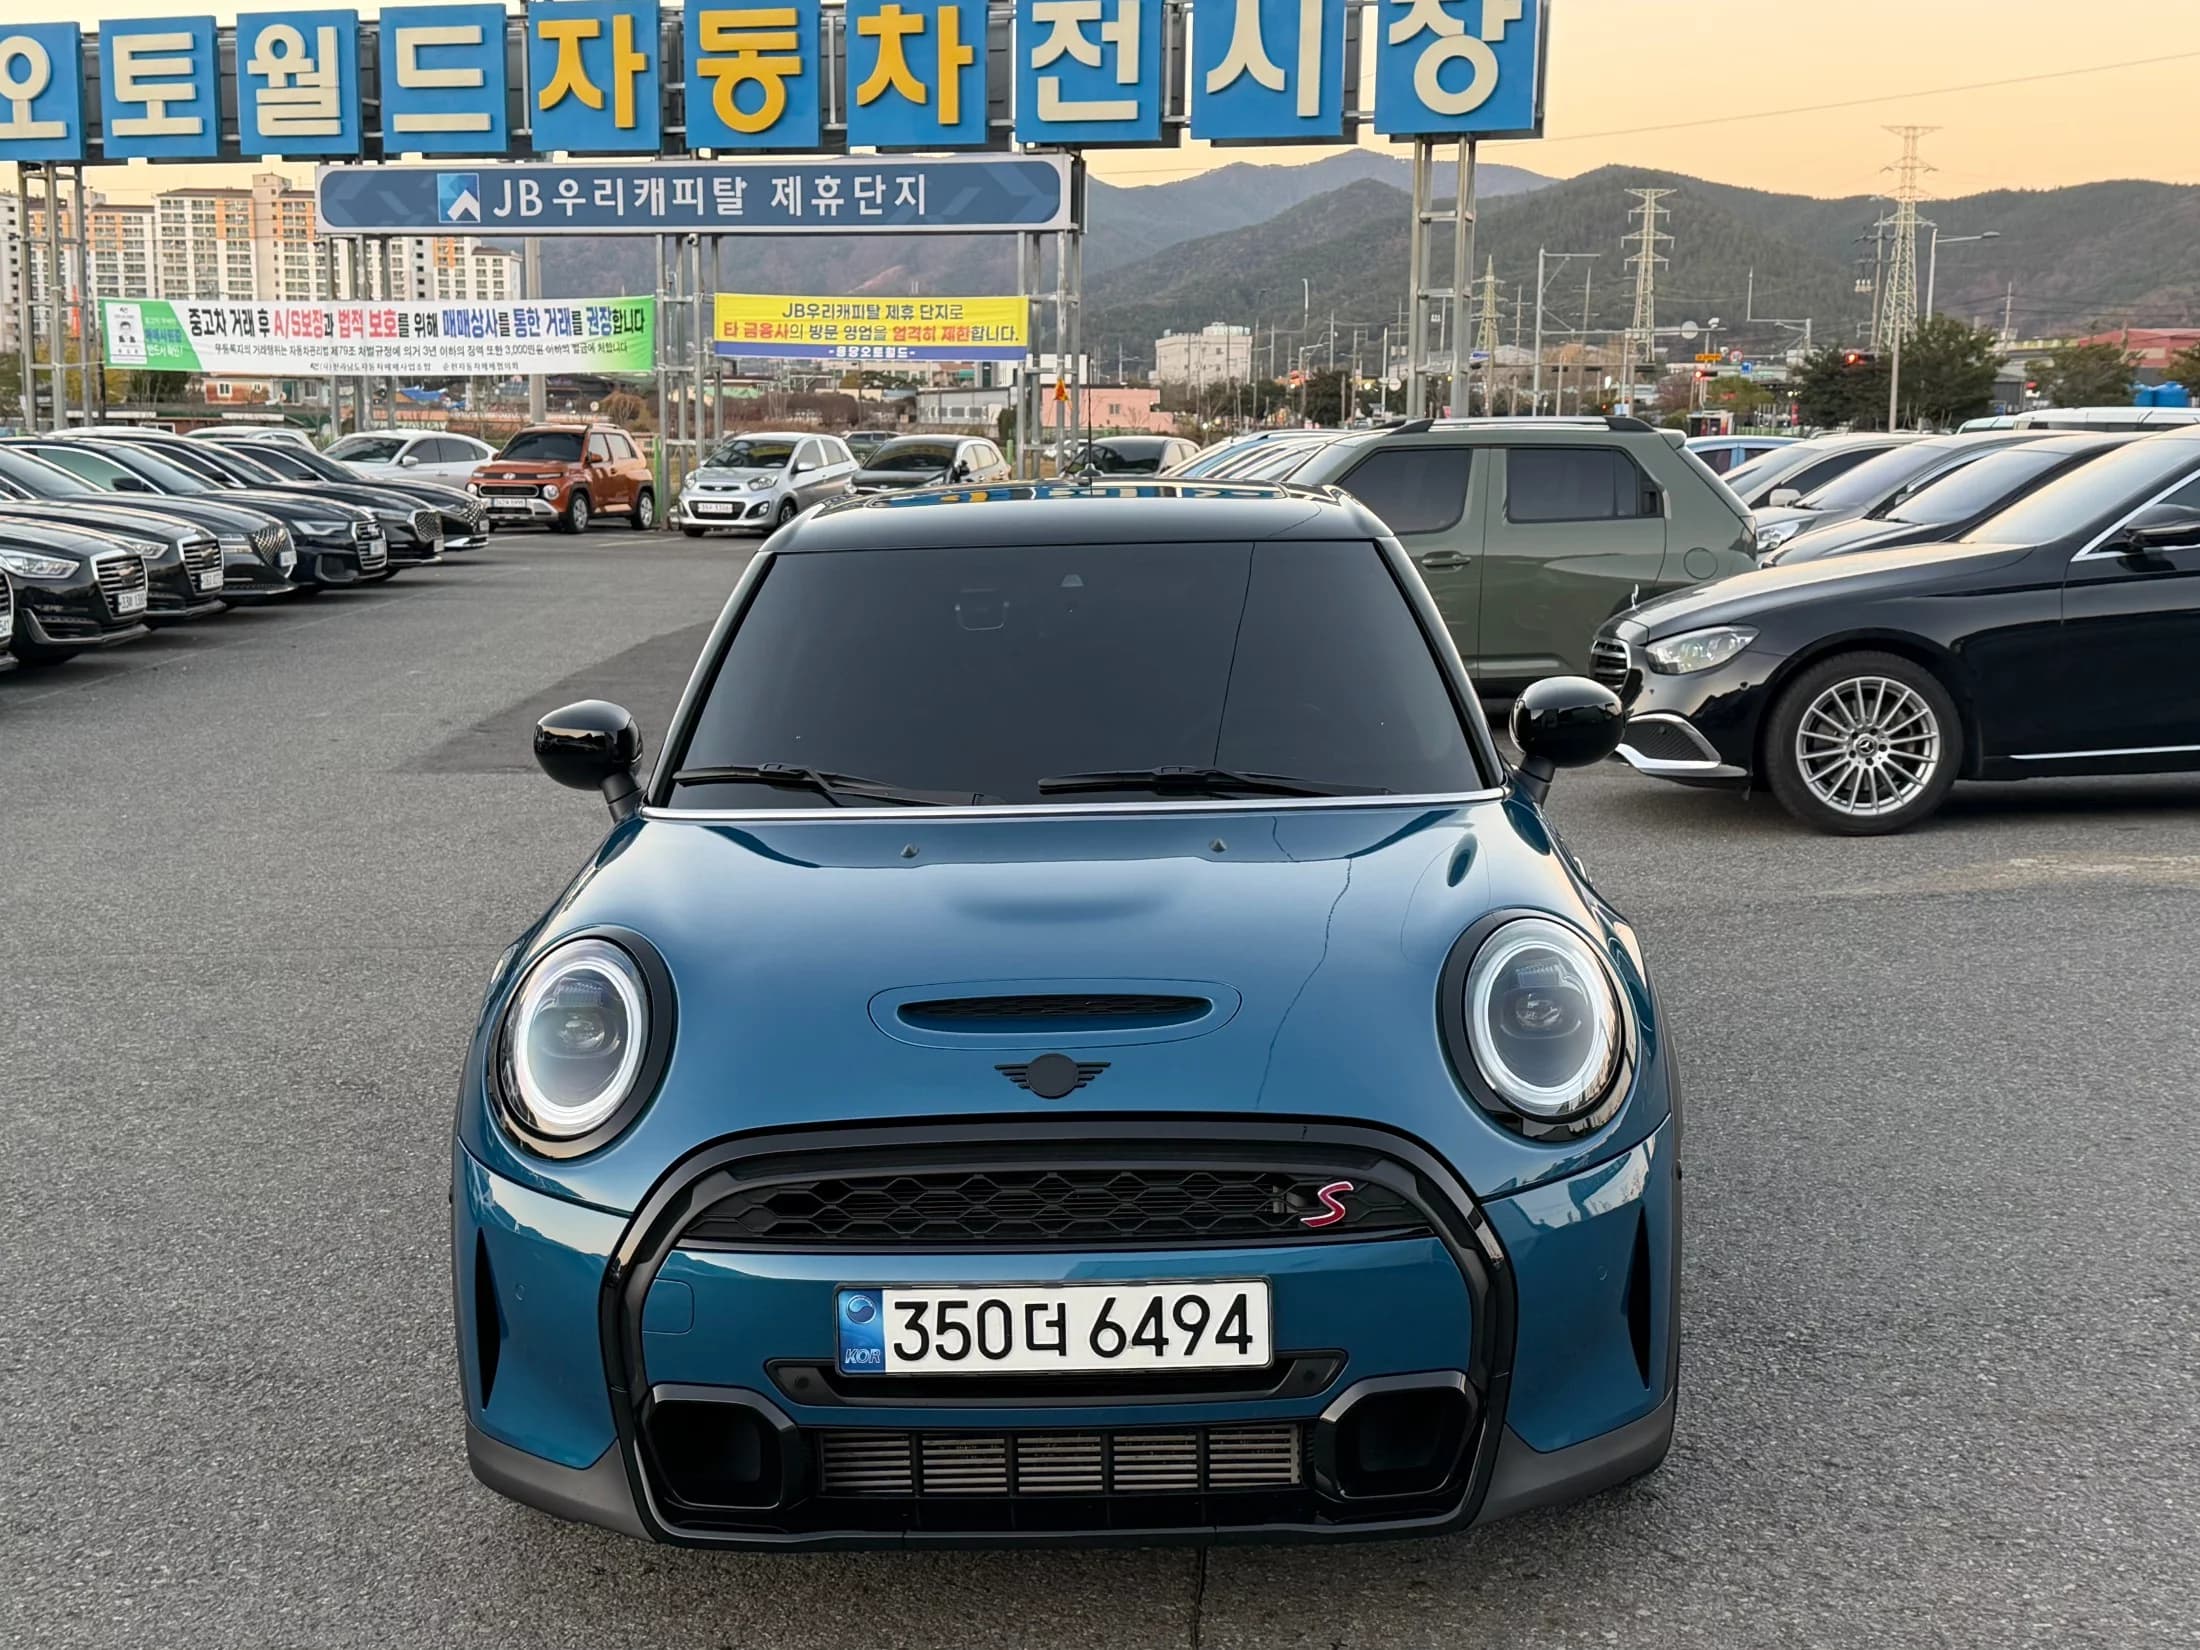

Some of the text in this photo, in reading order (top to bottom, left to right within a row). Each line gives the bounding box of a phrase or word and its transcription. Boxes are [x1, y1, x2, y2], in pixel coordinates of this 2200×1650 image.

[770, 174, 925, 216] 제휴단지
[188, 308, 227, 336] 중고차
[229, 308, 255, 337] 거래
[257, 308, 270, 338] 후
[274, 308, 334, 339] A/S보장과
[338, 309, 364, 338] 법적
[369, 309, 410, 338] 보호를
[414, 312, 439, 338] 위해
[442, 308, 510, 338] 매매상사를
[513, 307, 541, 337] 통한
[544, 307, 583, 337] 거래를
[586, 306, 645, 336] 권장합니다
[782, 303, 964, 320] JB우리캐피탈 제휴 단지로
[724, 321, 1019, 342] 타 금융사의 방문 영업을 엄격히 제한합니다.
[440, 345, 465, 357] 이하의
[1300, 1181, 1354, 1227] S
[893, 1293, 1254, 1361] 350더 6494
[844, 1347, 881, 1365] KOR
